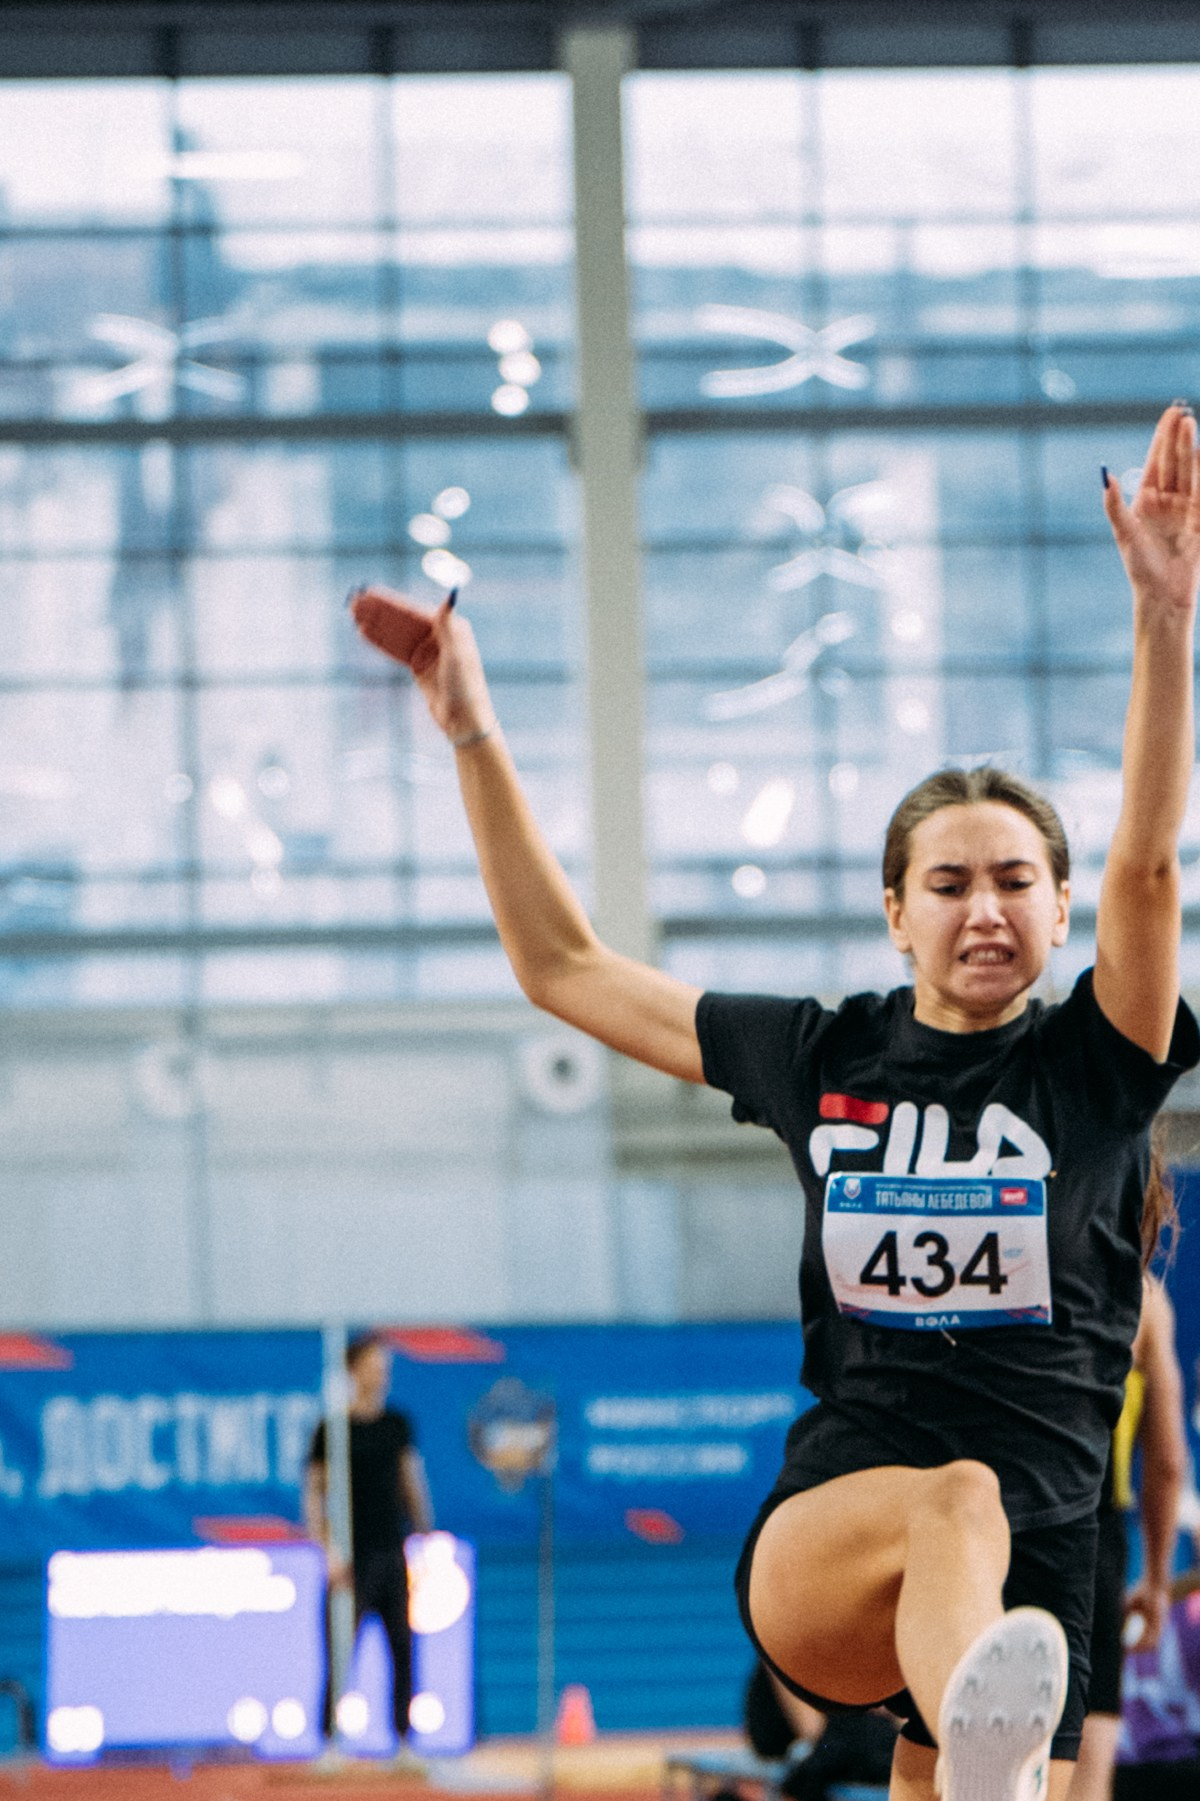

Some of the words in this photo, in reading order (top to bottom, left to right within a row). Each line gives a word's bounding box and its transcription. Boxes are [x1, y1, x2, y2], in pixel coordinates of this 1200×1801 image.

[809, 1092, 1052, 1180] FILA
[875, 1190, 926, 1209] ТАТЬЯНЫ
[928, 1188, 993, 1211] ЛЕБЕДЕВОЙ
[859, 1230, 1008, 1297] 434
